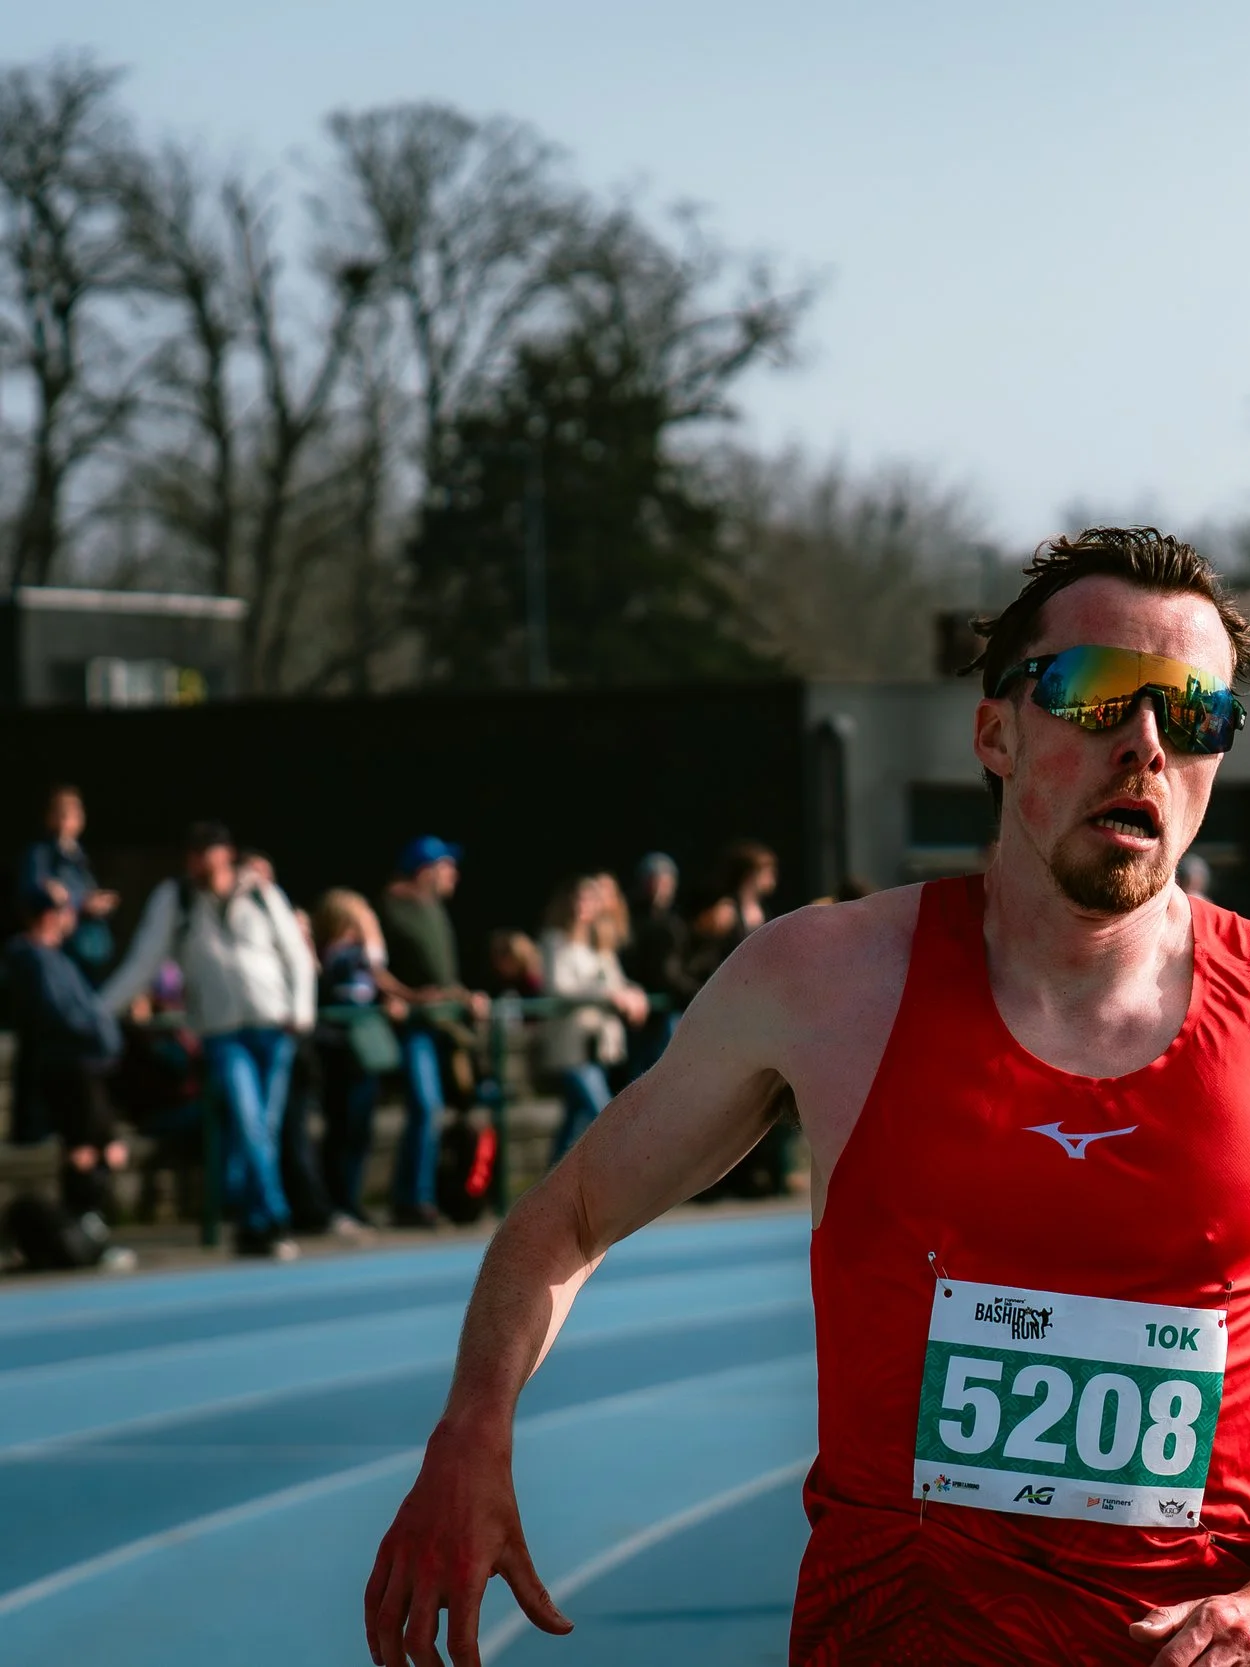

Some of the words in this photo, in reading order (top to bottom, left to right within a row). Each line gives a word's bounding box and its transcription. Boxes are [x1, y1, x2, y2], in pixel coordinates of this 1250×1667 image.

[1012, 1320, 1040, 1340] RUN
[1145, 1323, 1201, 1351] 10K
[939, 1355, 1202, 1476] 5208
[1013, 1485, 1055, 1505] AG
[1102, 1498, 1134, 1506] runners'
[1102, 1503, 1114, 1511] lab
